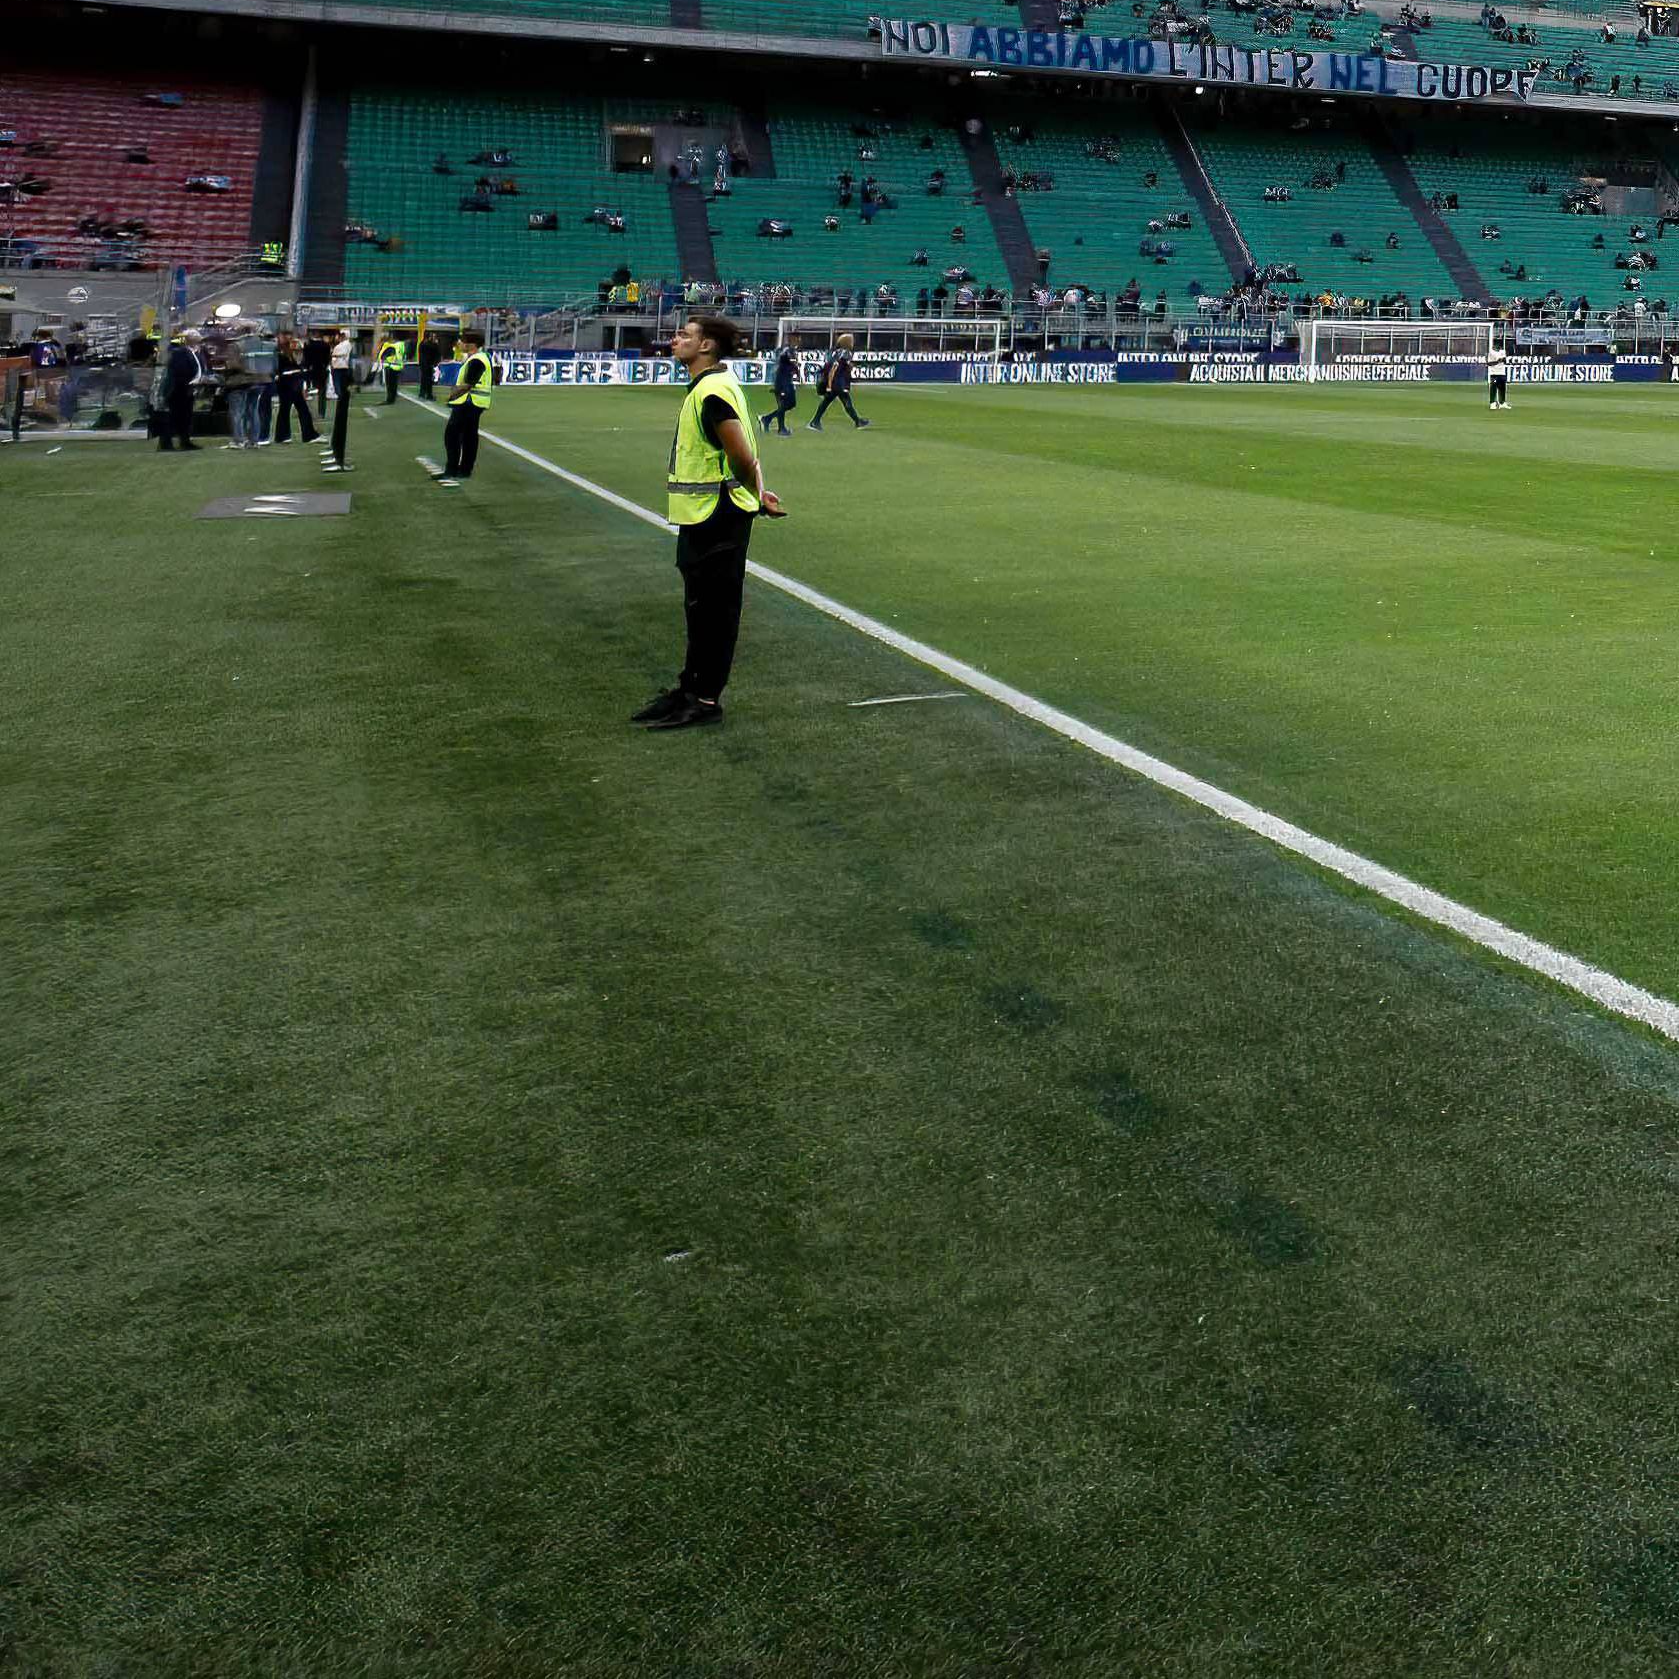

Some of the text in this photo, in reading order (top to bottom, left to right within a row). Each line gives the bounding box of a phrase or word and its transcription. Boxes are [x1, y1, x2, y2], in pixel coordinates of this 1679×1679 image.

[884, 19, 950, 56] NOI
[967, 26, 1155, 73] ABBIAMO
[1329, 53, 1396, 94] NEL
[1011, 363, 1066, 384] ONLINE
[1068, 364, 1118, 383] STORE
[1189, 364, 1254, 384] ACQUISTA
[1531, 364, 1575, 383] ONLINE
[1576, 365, 1614, 382] STORE
